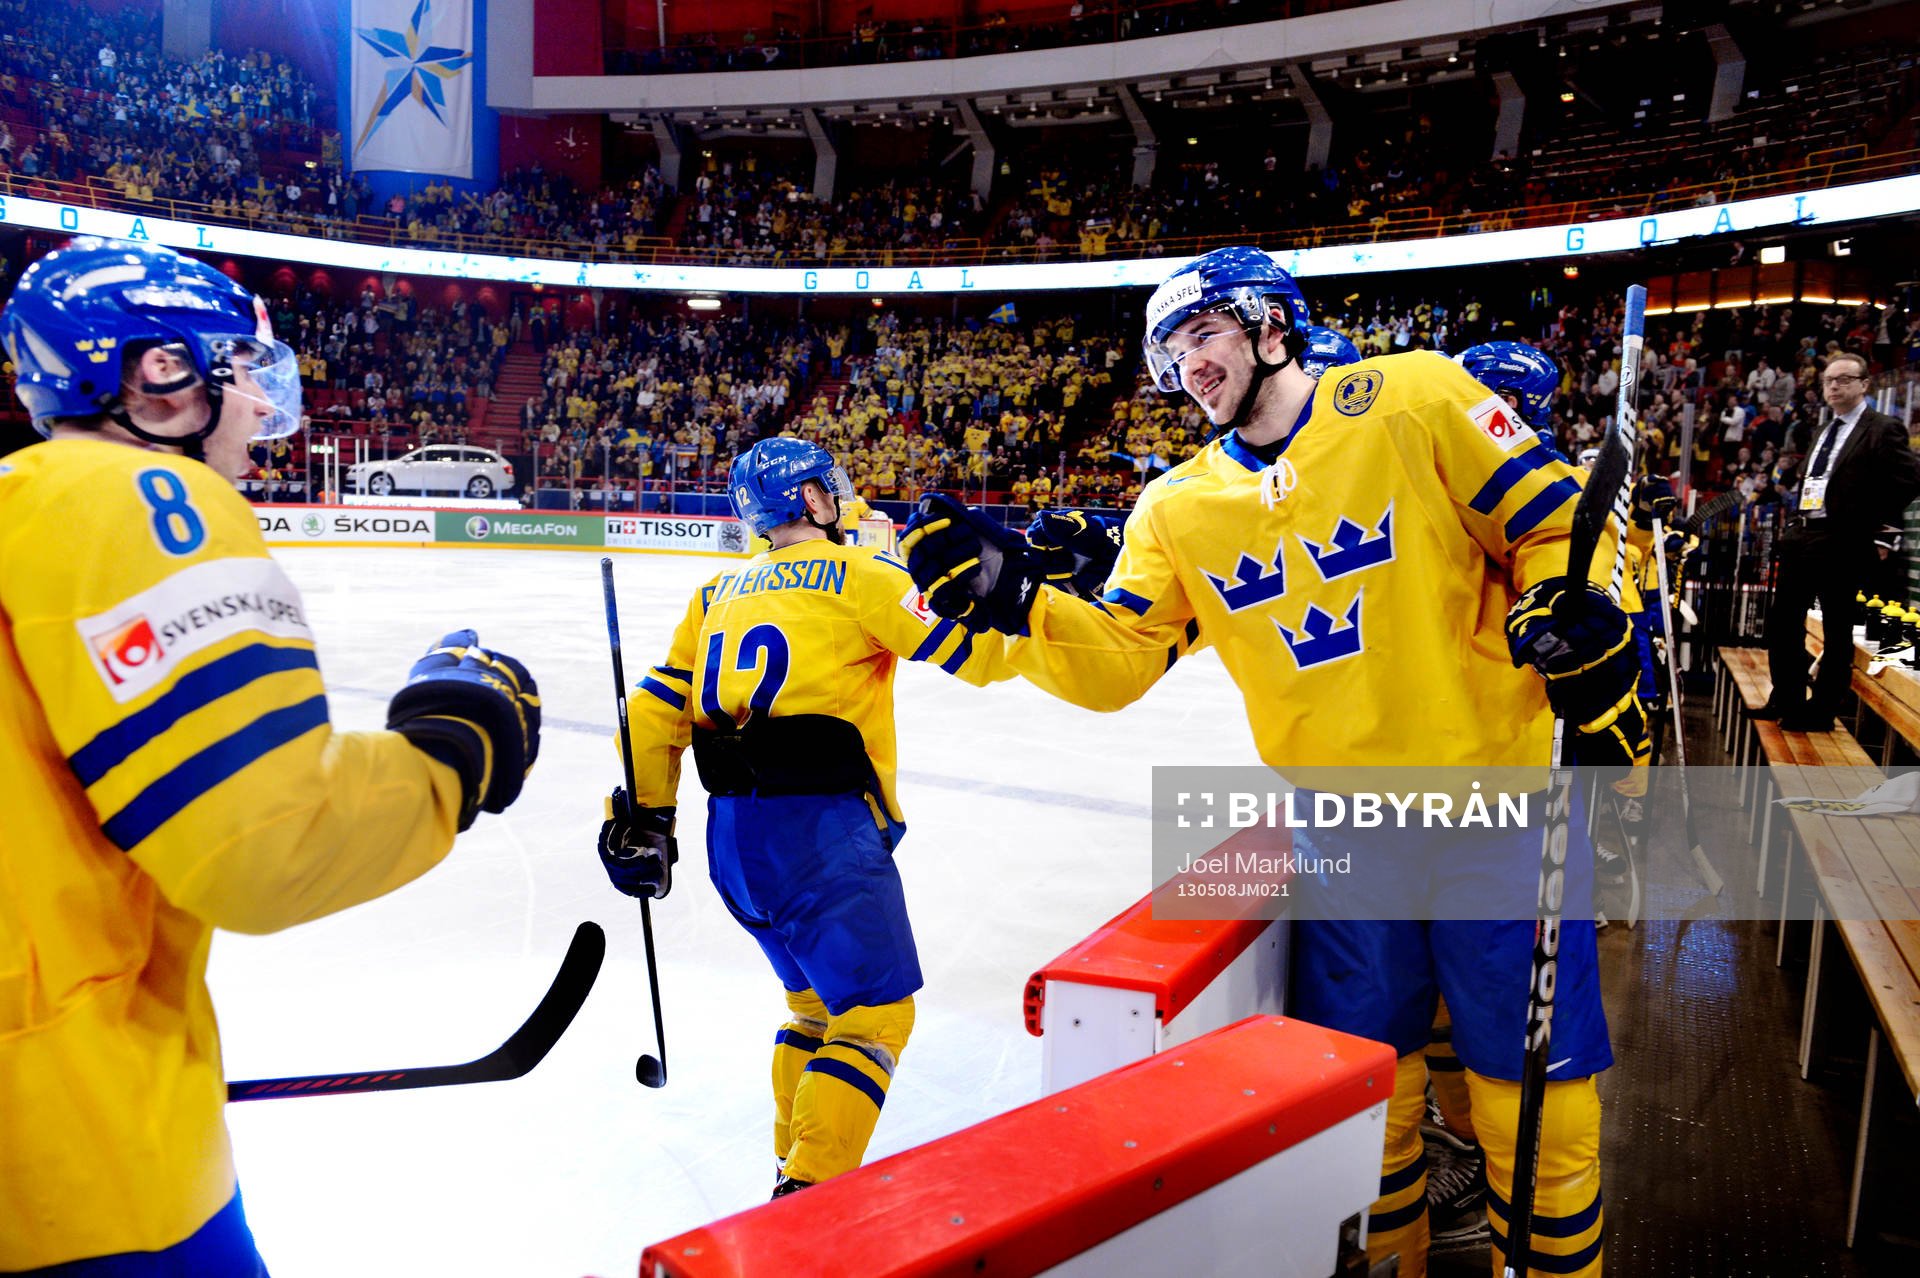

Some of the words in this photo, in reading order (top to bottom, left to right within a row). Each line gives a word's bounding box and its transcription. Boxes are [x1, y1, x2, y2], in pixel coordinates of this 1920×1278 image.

[804, 269, 974, 290] GOAL
[762, 455, 788, 470] CCM
[734, 486, 751, 509] 12
[137, 467, 206, 557] 8
[334, 514, 431, 533] ŠKODA
[639, 521, 714, 538] TISSOT
